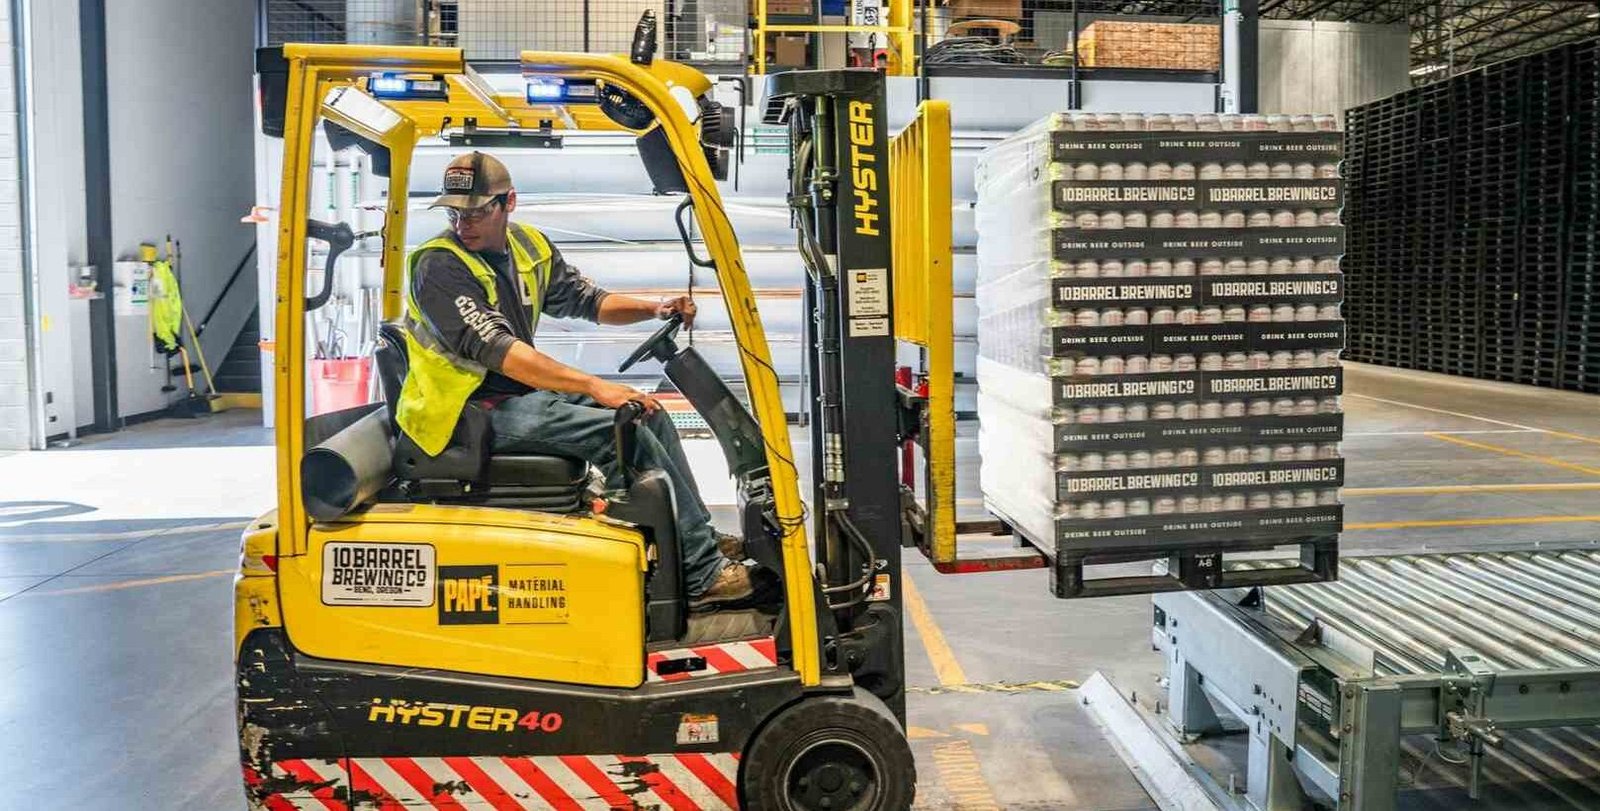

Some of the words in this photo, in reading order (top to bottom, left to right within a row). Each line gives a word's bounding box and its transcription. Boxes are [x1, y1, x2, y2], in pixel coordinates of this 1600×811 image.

[850, 101, 879, 236] HYSTER
[1210, 520, 1241, 528] OUTSIDE
[508, 597, 566, 609] HANDLING
[368, 698, 518, 732] HYSTER
[518, 711, 563, 732] 40
